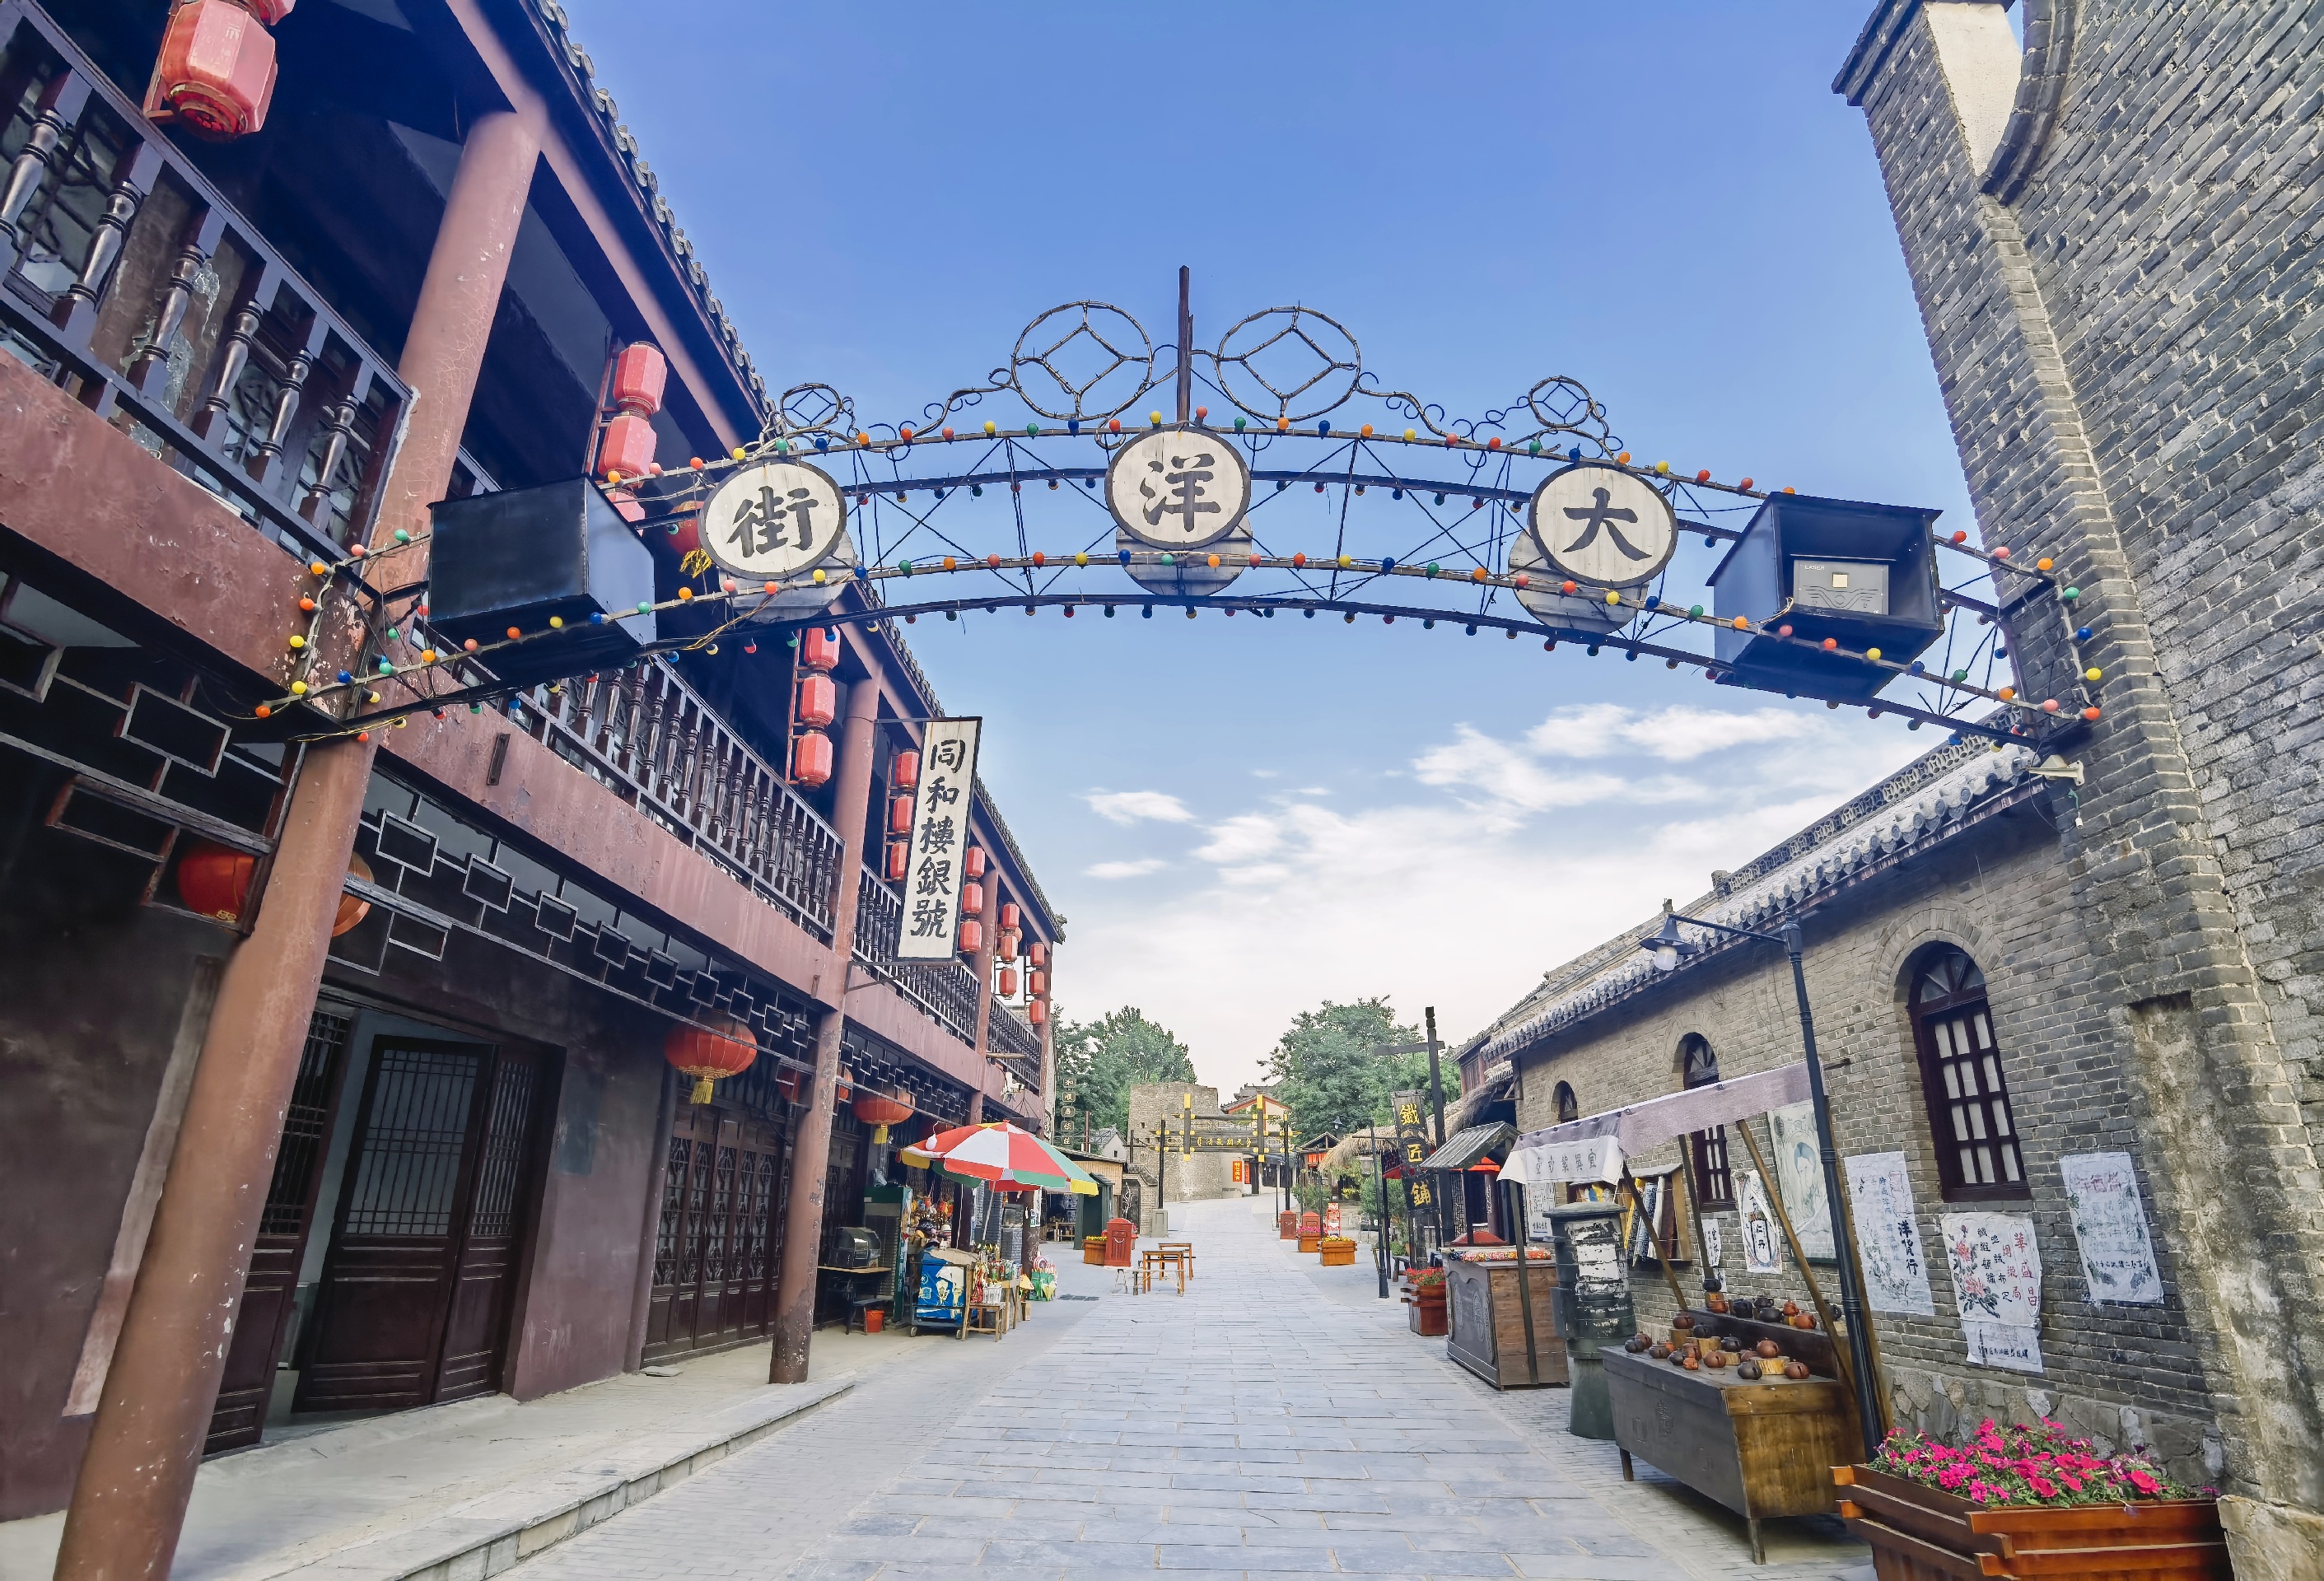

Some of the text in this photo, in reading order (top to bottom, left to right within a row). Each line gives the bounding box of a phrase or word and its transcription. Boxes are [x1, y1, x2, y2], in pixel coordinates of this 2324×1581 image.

[728, 453, 1652, 562] 大 洋 街
[910, 739, 966, 939] 同和樓銀號
